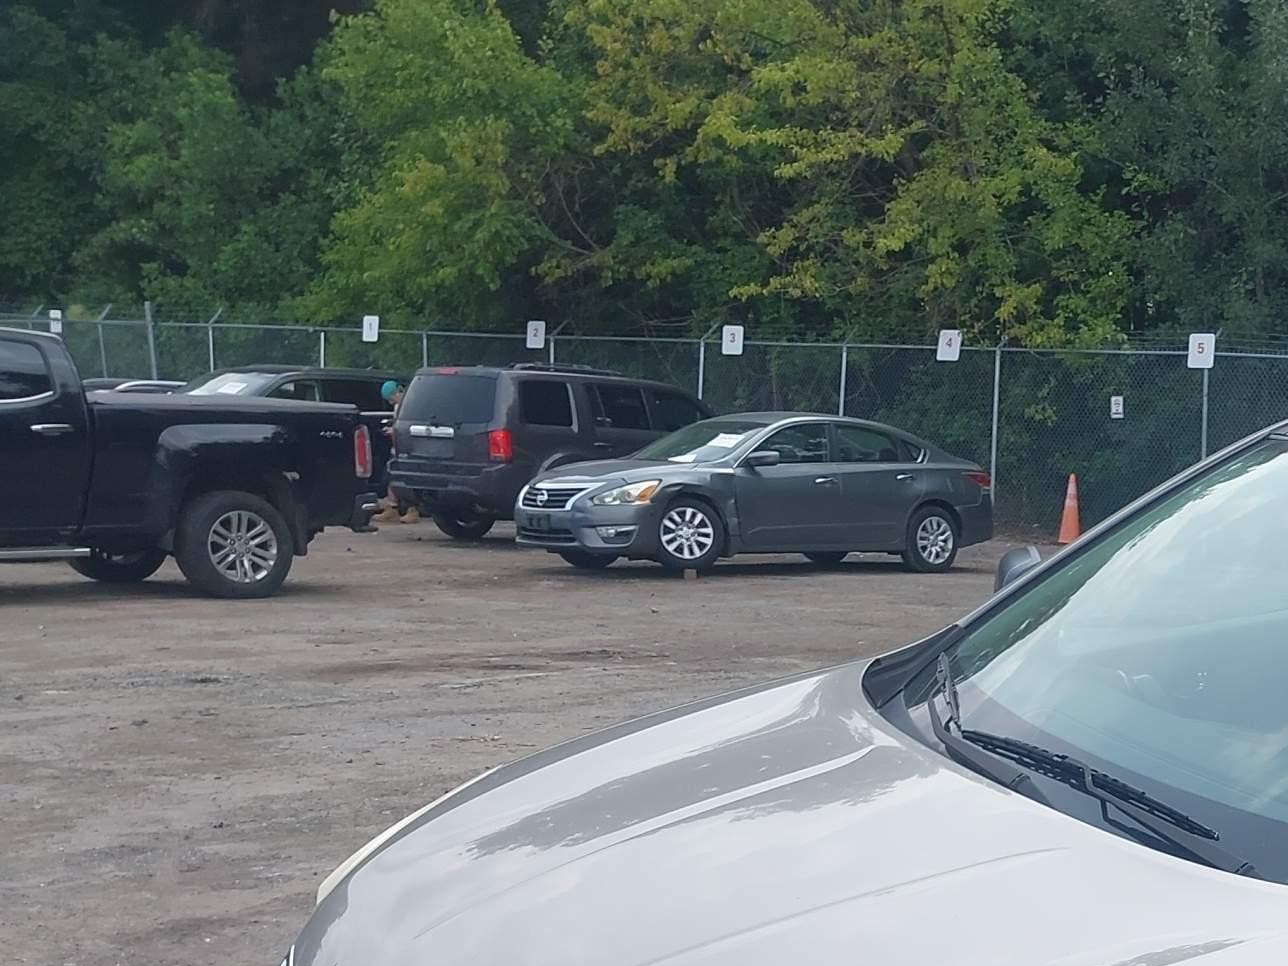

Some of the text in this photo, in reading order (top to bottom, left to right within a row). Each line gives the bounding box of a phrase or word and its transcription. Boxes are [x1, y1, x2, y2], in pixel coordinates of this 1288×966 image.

[532, 328, 539, 338] 2
[729, 333, 736, 343] 3
[945, 337, 952, 348] 4
[1197, 343, 1205, 354] 5
